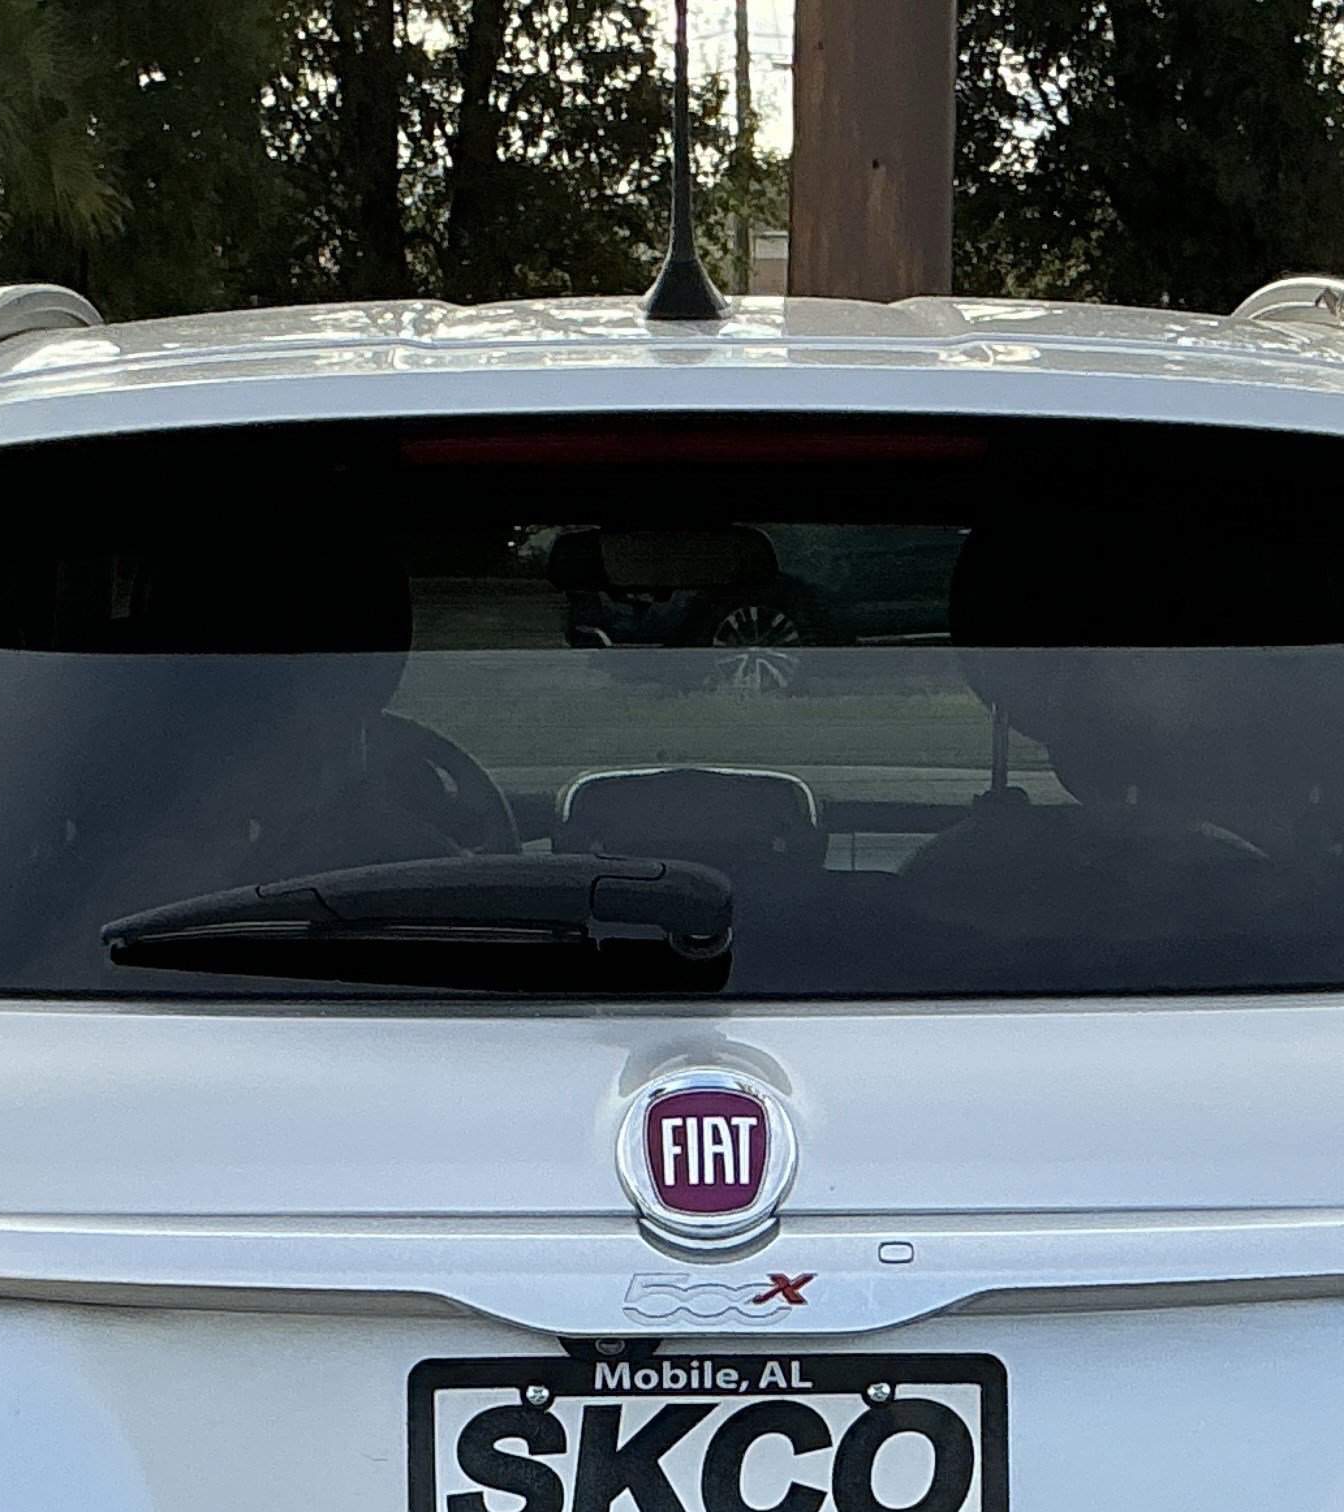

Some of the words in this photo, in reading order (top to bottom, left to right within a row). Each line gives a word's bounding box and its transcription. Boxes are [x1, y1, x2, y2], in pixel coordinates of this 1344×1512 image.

[661, 1116, 758, 1186] FIAT
[594, 1362, 749, 1392] Mobile,
[759, 1361, 813, 1389] AL
